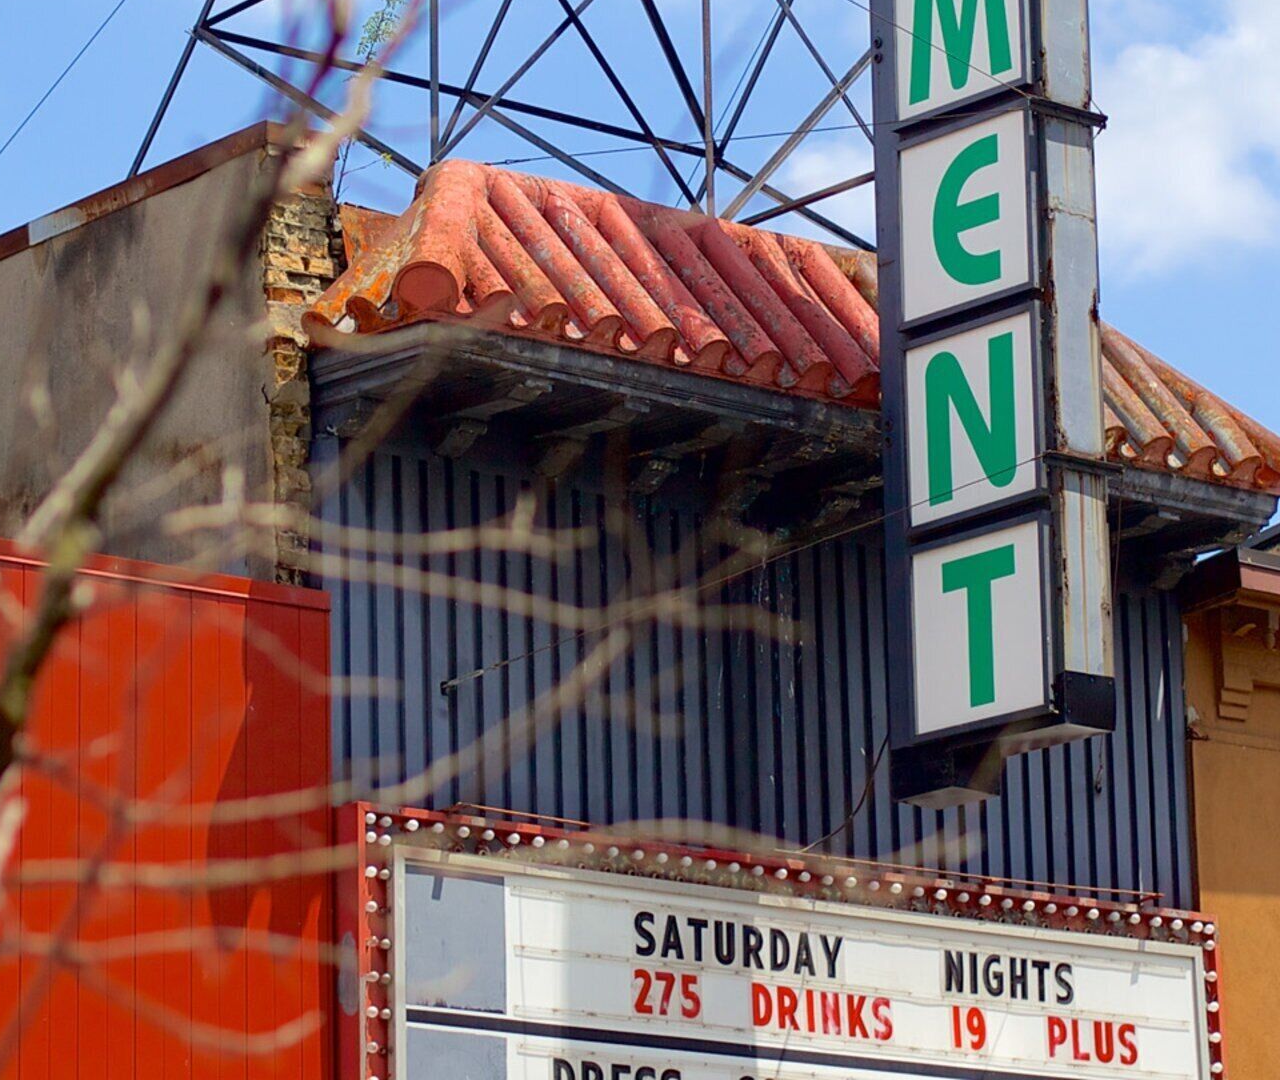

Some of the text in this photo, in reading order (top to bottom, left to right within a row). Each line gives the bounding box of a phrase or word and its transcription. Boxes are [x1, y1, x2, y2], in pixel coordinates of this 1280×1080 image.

[633, 911, 1075, 1005] SATURDAY NIGHTS
[633, 968, 1139, 1065] 275 DRINKS 19 PLUS
